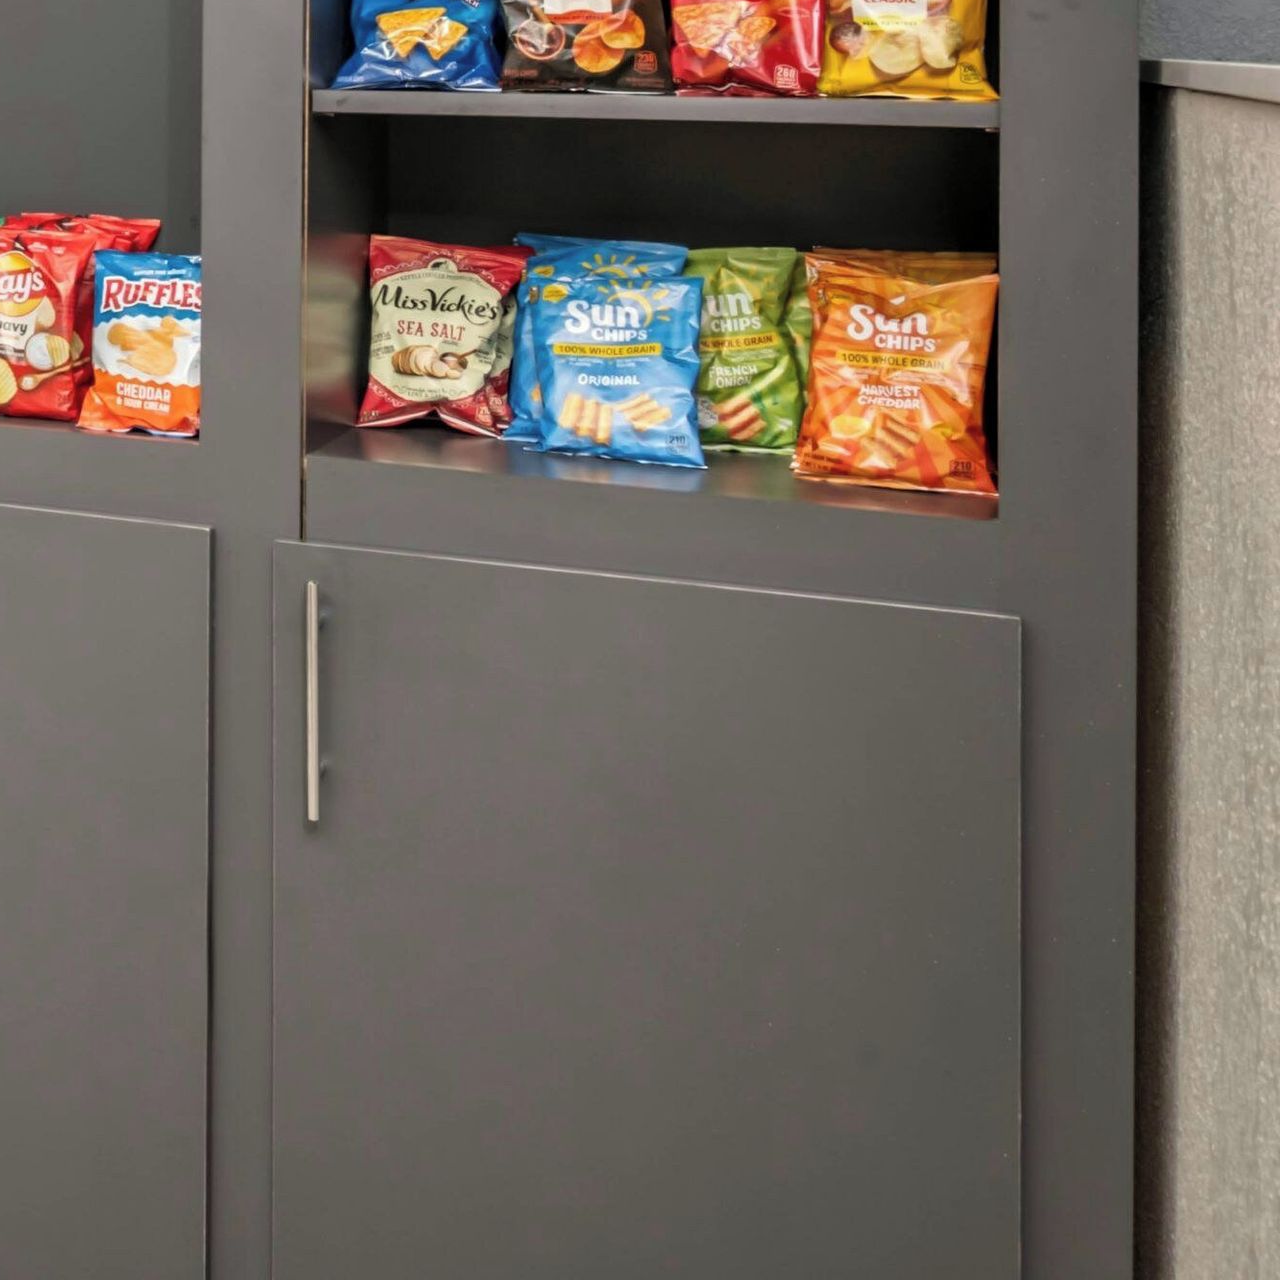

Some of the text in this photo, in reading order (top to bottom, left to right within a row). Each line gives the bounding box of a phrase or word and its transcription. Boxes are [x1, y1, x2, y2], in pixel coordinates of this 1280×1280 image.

[373, 285, 498, 326] Miss Vickie's
[564, 299, 641, 334] Sun
[711, 316, 762, 332] CHIPS
[847, 303, 928, 341] Sun
[397, 319, 466, 342] SEA SALT
[590, 328, 648, 342] CHIPS
[743, 335, 774, 347] GRAIN
[874, 333, 936, 352] CHIPS
[559, 345, 657, 356] 100% WHOLE GRAIN
[842, 353, 946, 371] 100% WHOLE GRAIN
[709, 364, 758, 379] FRENCH
[715, 375, 752, 389] ONION
[116, 381, 171, 401] CHEDDAR
[860, 384, 920, 398] HARVEST
[143, 400, 170, 414] CREAM
[858, 395, 920, 410] CHEDDAR
